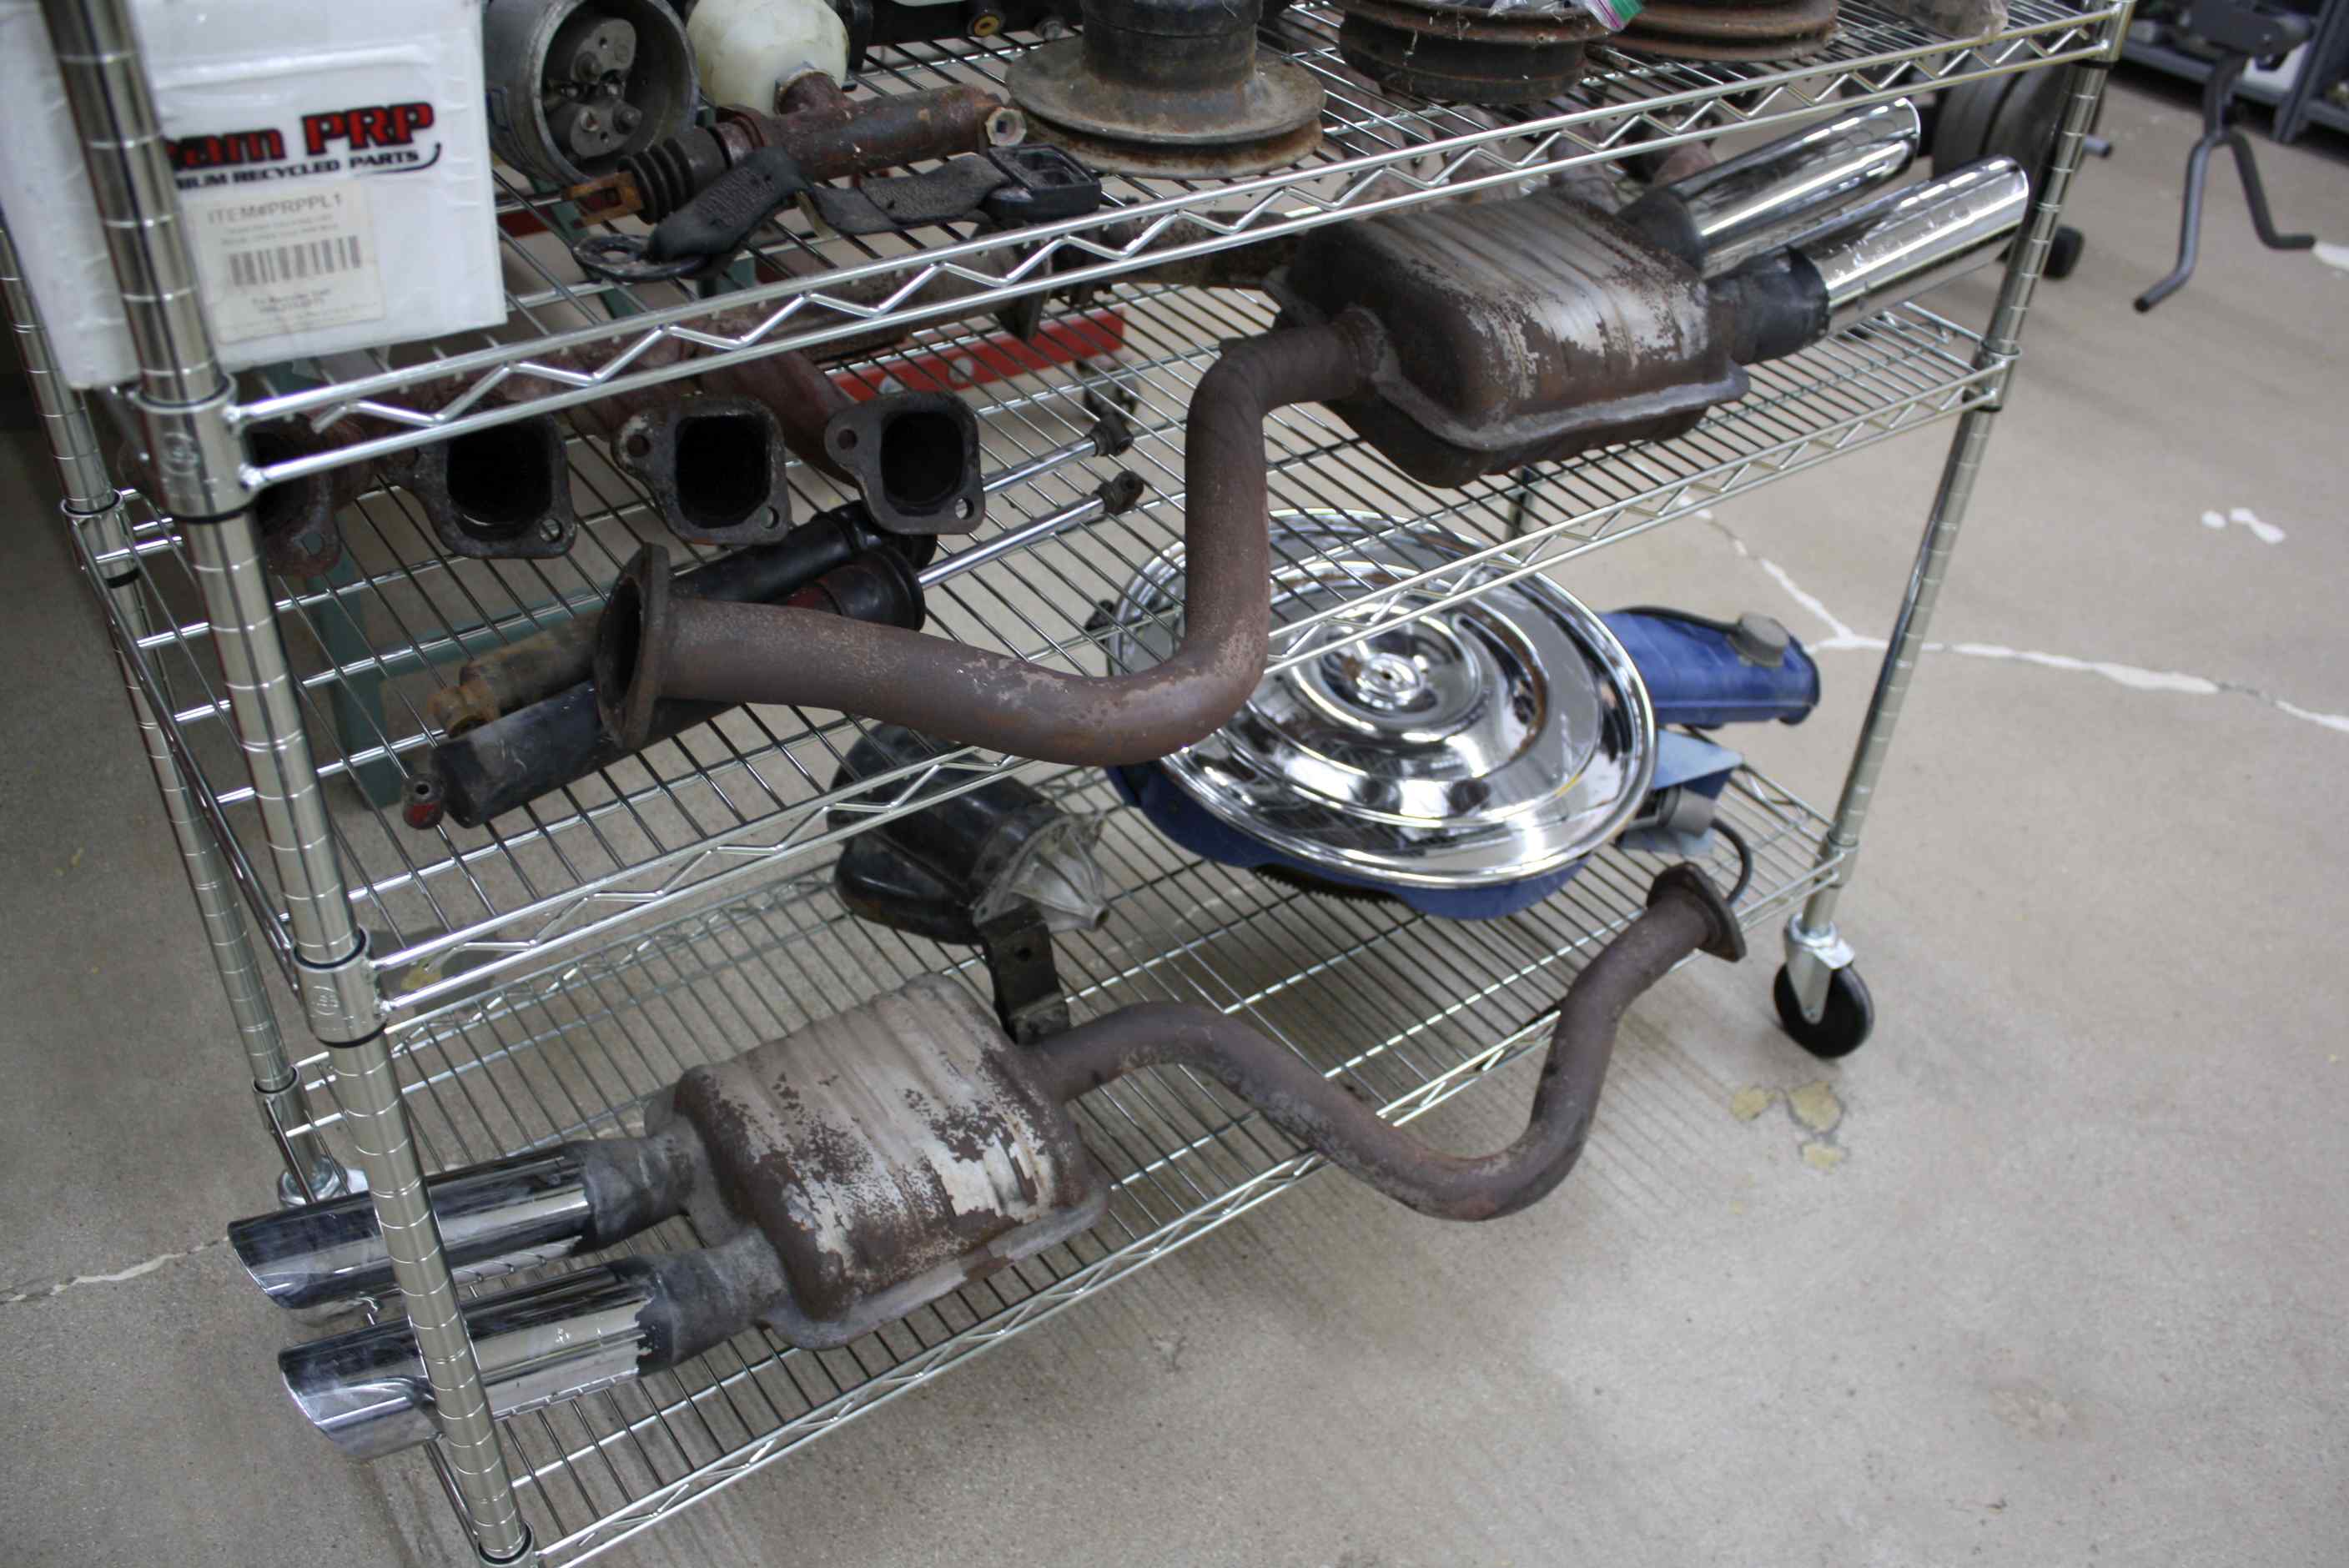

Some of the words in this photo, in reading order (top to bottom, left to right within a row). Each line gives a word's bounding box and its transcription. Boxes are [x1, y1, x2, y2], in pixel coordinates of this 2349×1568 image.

[301, 102, 435, 157] PRP
[231, 159, 340, 183] RECYCLED
[349, 150, 420, 168] PARTS
